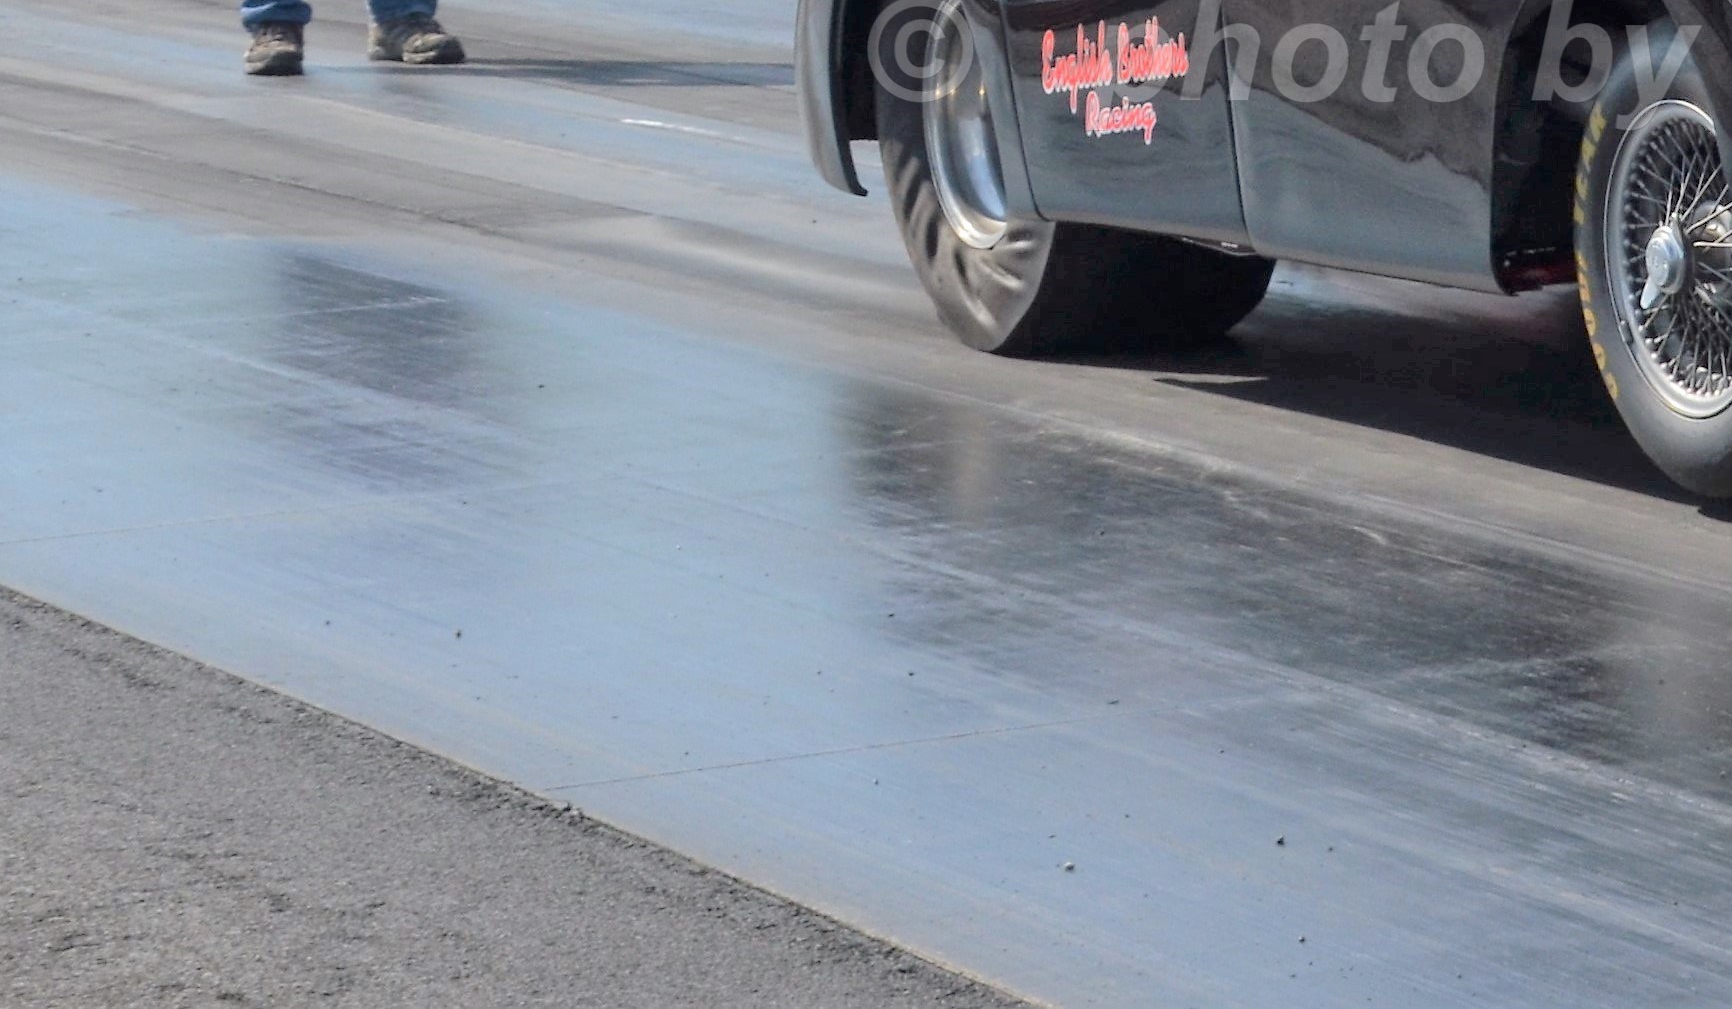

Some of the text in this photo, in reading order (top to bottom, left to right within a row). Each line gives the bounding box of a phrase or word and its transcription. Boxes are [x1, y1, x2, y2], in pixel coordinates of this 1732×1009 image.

[1041, 15, 1190, 115] English Brothers
[1084, 90, 1157, 146] Racing
